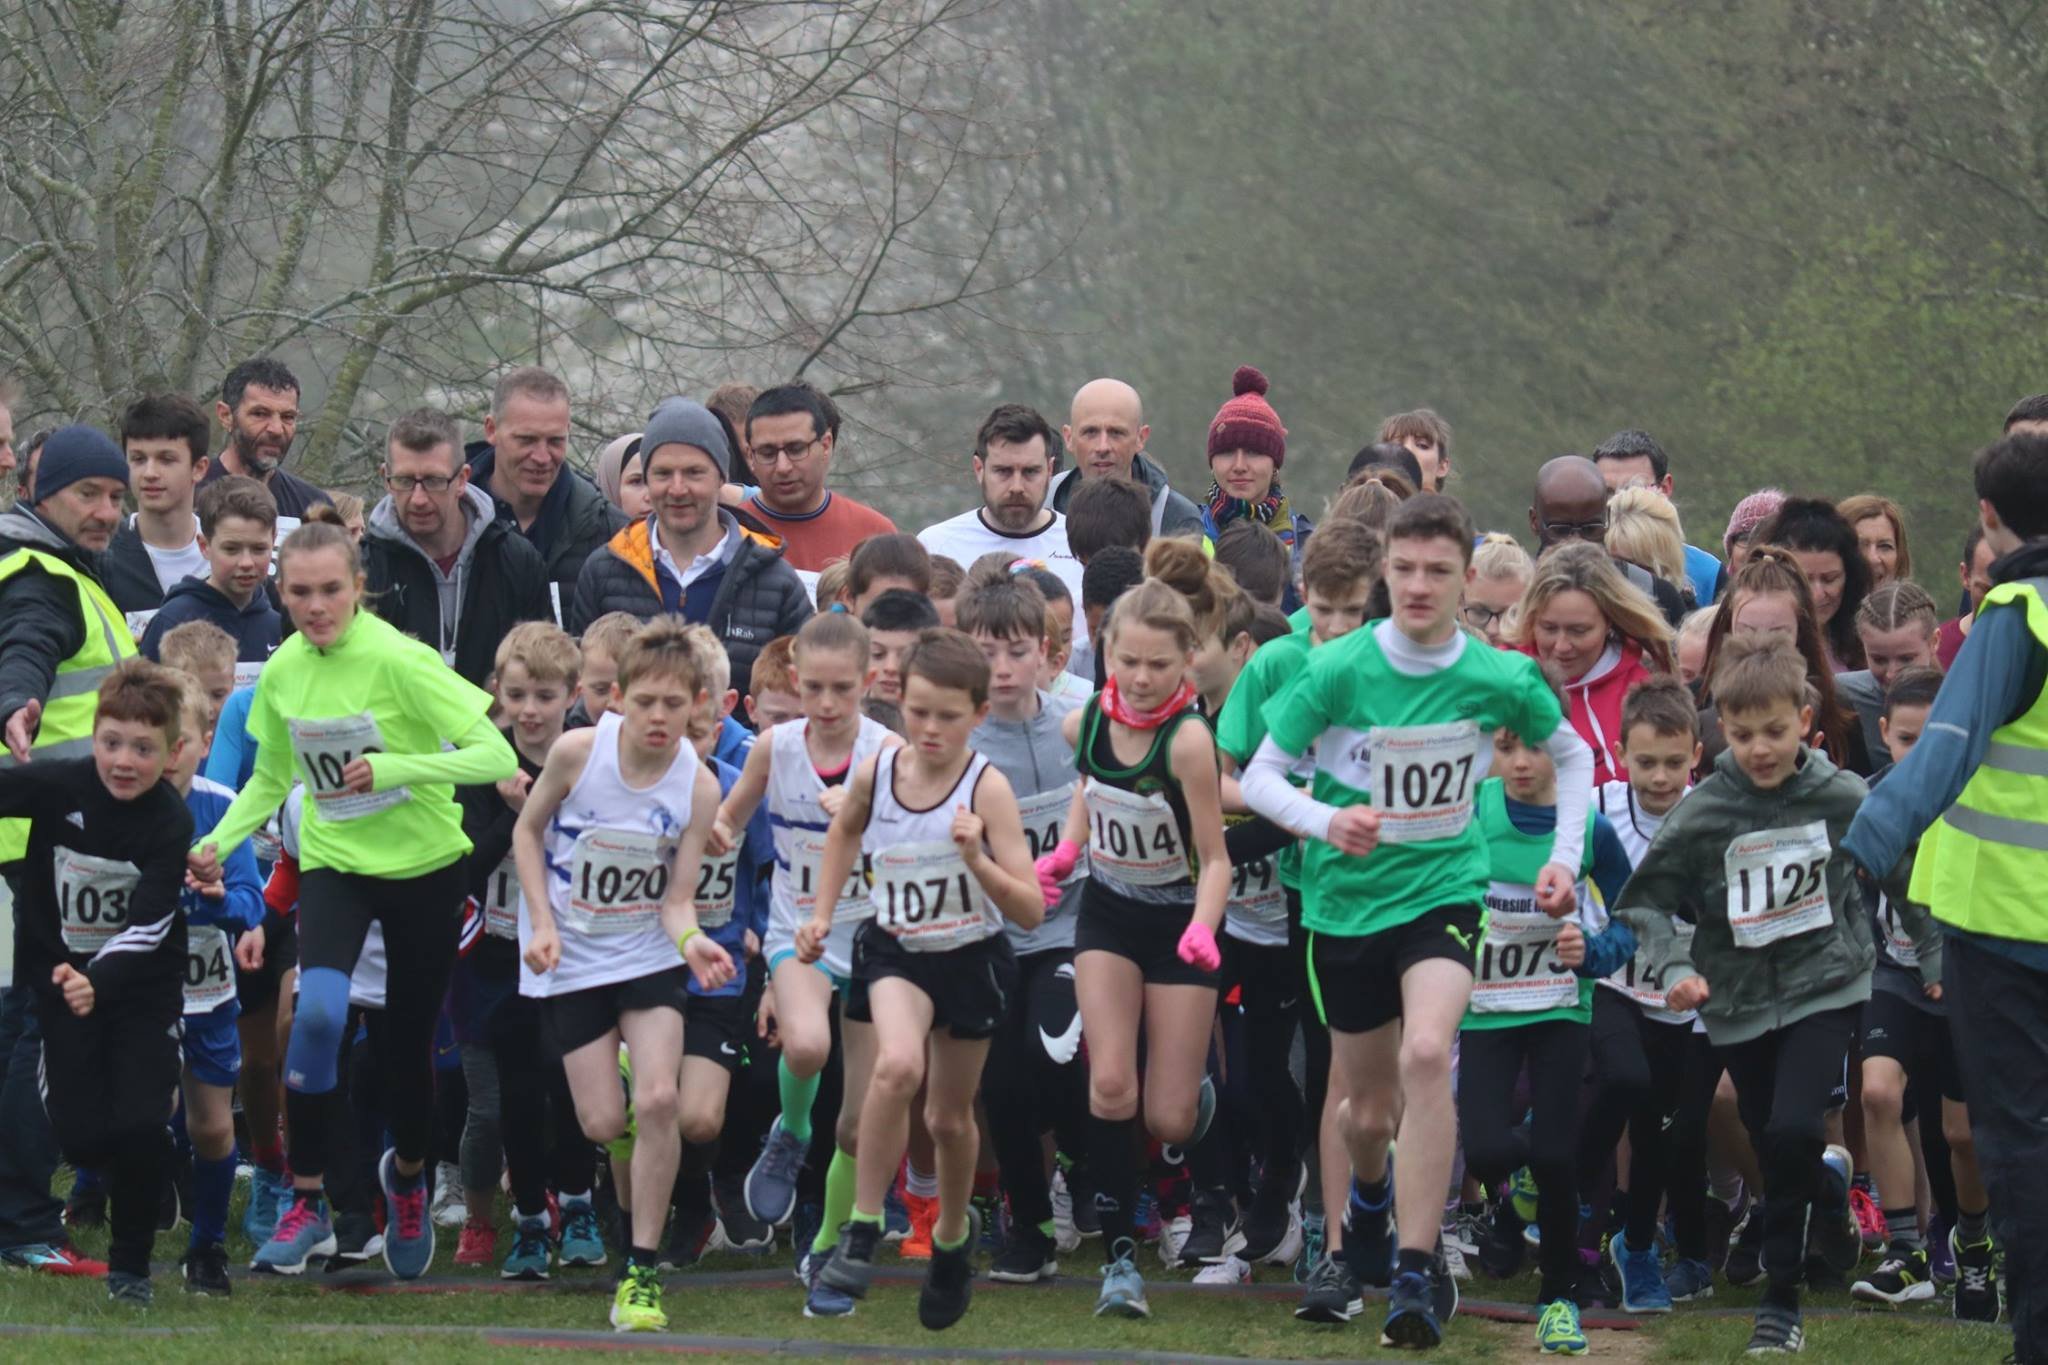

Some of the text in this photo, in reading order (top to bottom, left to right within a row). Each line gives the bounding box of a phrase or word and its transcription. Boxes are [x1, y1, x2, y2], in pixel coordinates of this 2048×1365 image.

[1384, 752, 1475, 809] 1027
[1096, 811, 1177, 860] 1014
[581, 860, 669, 904] 1020
[694, 862, 736, 900] 25
[886, 873, 972, 925] 1071
[1739, 857, 1826, 913] 1125
